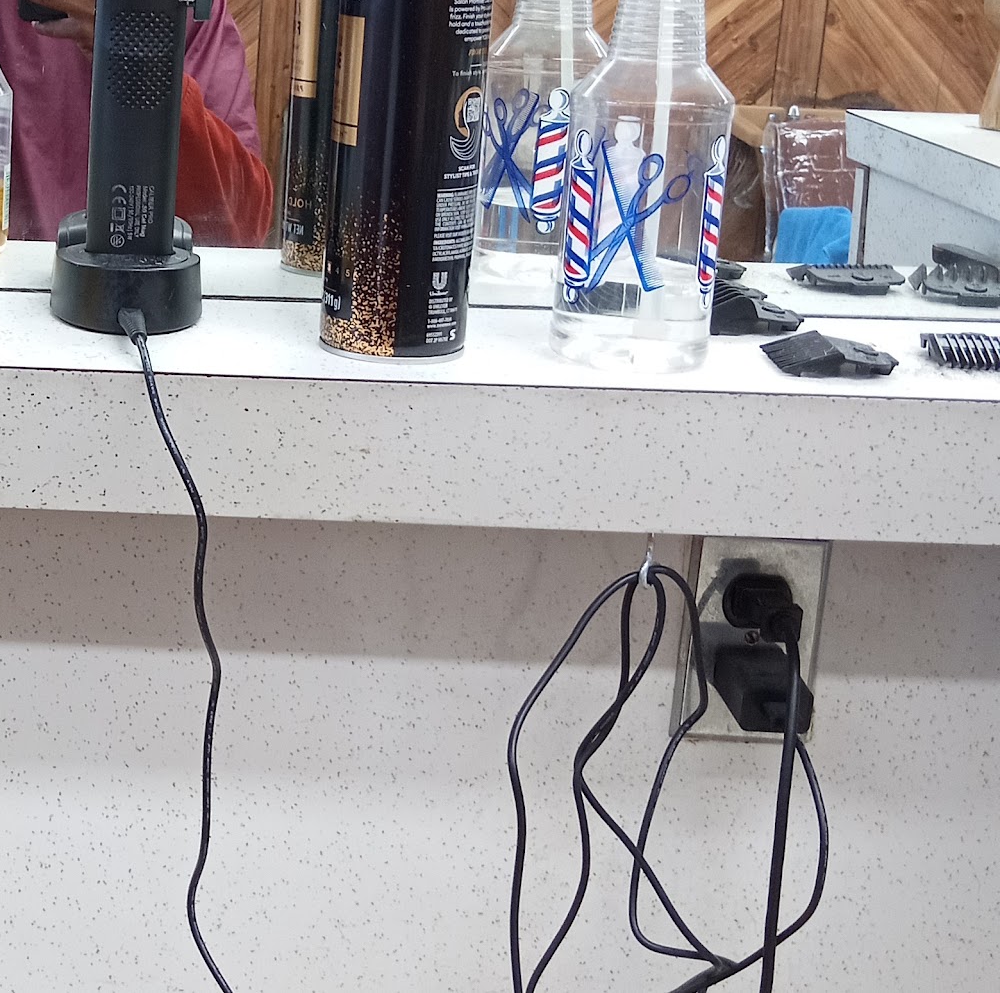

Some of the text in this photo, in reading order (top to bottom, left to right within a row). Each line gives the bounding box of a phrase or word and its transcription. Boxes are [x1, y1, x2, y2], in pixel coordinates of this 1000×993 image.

[454, 6, 476, 14] powered
[462, 12, 476, 20] Finish
[344, 268, 351, 278] 5
